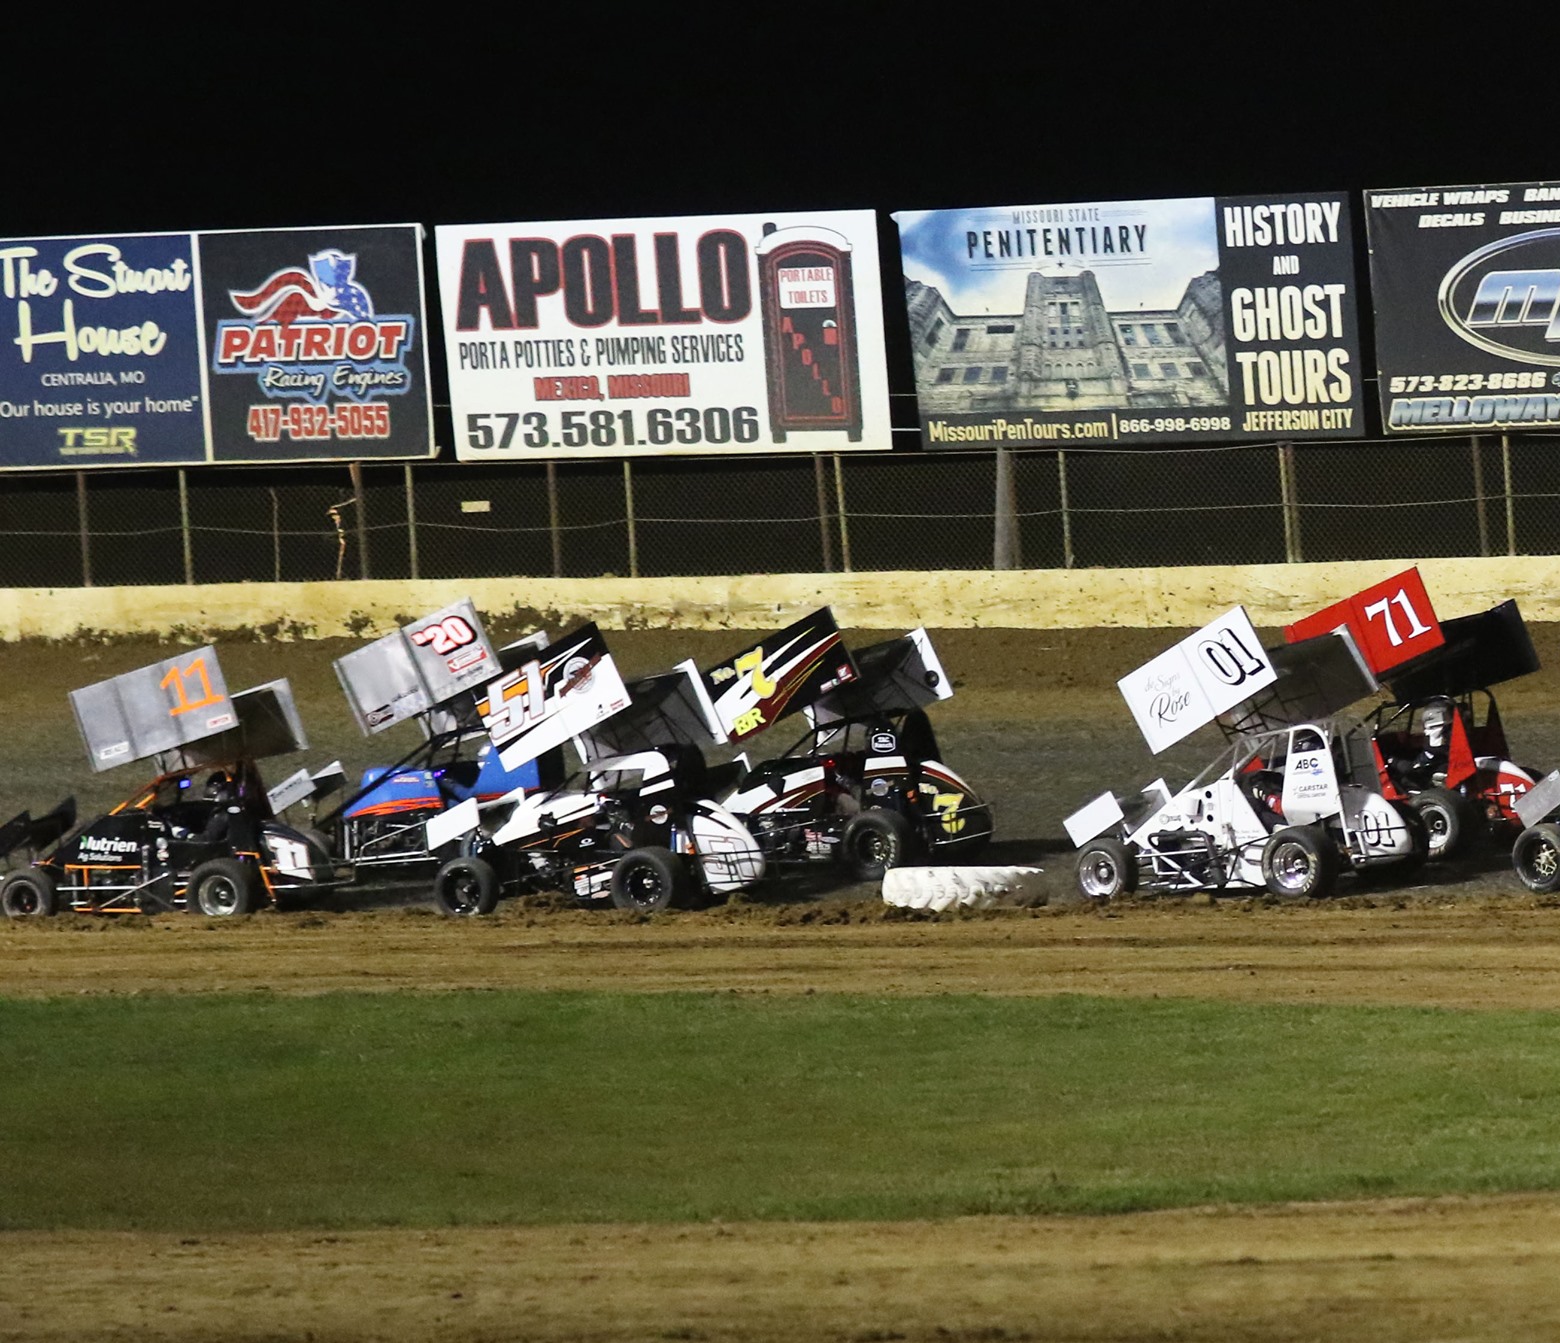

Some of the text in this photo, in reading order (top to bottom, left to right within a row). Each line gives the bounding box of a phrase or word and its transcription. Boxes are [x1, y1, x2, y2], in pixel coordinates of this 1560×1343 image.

[1012, 208, 1100, 224] MISSOURI STATE
[1371, 192, 1439, 209] VEHICLE
[1443, 189, 1509, 206] WRAPS
[1223, 202, 1341, 248] HISTORY
[1418, 212, 1485, 228] DECALS
[966, 224, 1148, 259] PENITENTIARY
[0, 244, 192, 299] The Stuart
[456, 229, 752, 331] APOLLO
[780, 269, 833, 283] PORTABLE
[1272, 255, 1299, 276] AND
[788, 290, 828, 304] TOILETS
[1230, 284, 1346, 343] GHOST
[14, 298, 167, 363] House
[217, 322, 406, 364] PATRIOT
[459, 333, 745, 370] PORTA POTTIES & PUMPING SERVICES
[41, 370, 145, 387] CENTRALIA, MO
[263, 365, 404, 396] Racing Engines
[534, 373, 691, 401] MEXICO, MISSOURI
[1236, 347, 1351, 406] TOURS
[1389, 372, 1547, 393] 573-823-8686
[34, 397, 83, 416] house
[87, 395, 101, 414] is
[104, 398, 141, 419] your
[247, 403, 391, 442] 417-932-5055
[1242, 407, 1352, 432] JEFFERSON CITY
[58, 427, 137, 448] TSR
[467, 406, 760, 450] 573.581.6306
[929, 416, 1231, 442] MissouriPenTours.com 866-998-6998
[1364, 588, 1432, 648] 71
[734, 646, 777, 698] 7
[1197, 628, 1266, 686] 01
[160, 658, 224, 717] 11
[487, 660, 545, 740] 51
[1150, 692, 1190, 728] Rose
[1295, 758, 1319, 770] ABC
[932, 793, 966, 834] 7
[1360, 810, 1395, 847] 01
[79, 836, 137, 853] Nutrien
